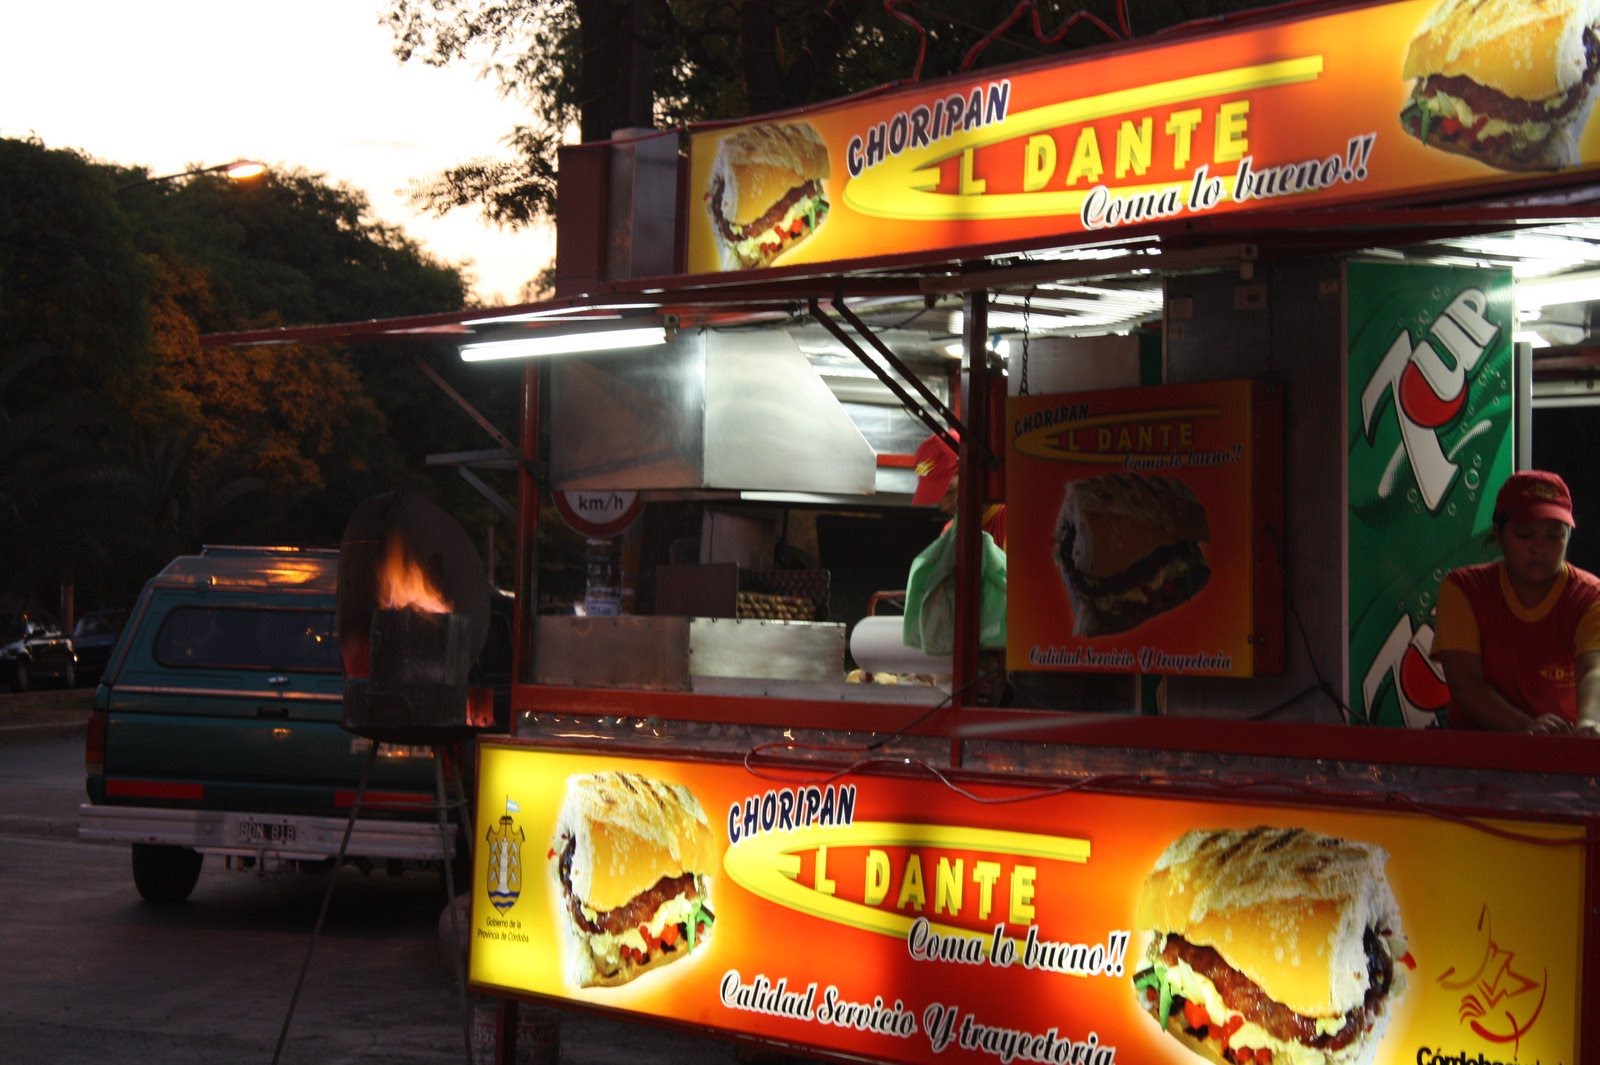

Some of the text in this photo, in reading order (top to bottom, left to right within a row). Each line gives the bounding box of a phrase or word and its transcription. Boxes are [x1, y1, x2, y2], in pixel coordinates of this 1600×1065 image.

[847, 79, 1011, 178] CHORIPAN
[1023, 99, 1250, 192] DANTE
[1081, 131, 1377, 230] Coma lo bueno!!
[1014, 403, 1089, 438] CHORIPAN
[1097, 423, 1194, 451] DANTE
[1123, 453, 1165, 472] Coma
[1169, 450, 1186, 468] lo
[578, 492, 624, 512] km/h
[1029, 644, 1233, 673] Calidad Servicio Y trayectoria
[727, 784, 857, 846] CHORIPAN
[864, 849, 1037, 926] DANTE
[477, 928, 529, 943] Provincia de Córdoba
[486, 916, 522, 930] Gobierno de la
[907, 916, 1130, 977] Coma lo bueno!!
[719, 968, 1118, 1065] Calidad Servicio Y trayectoria
